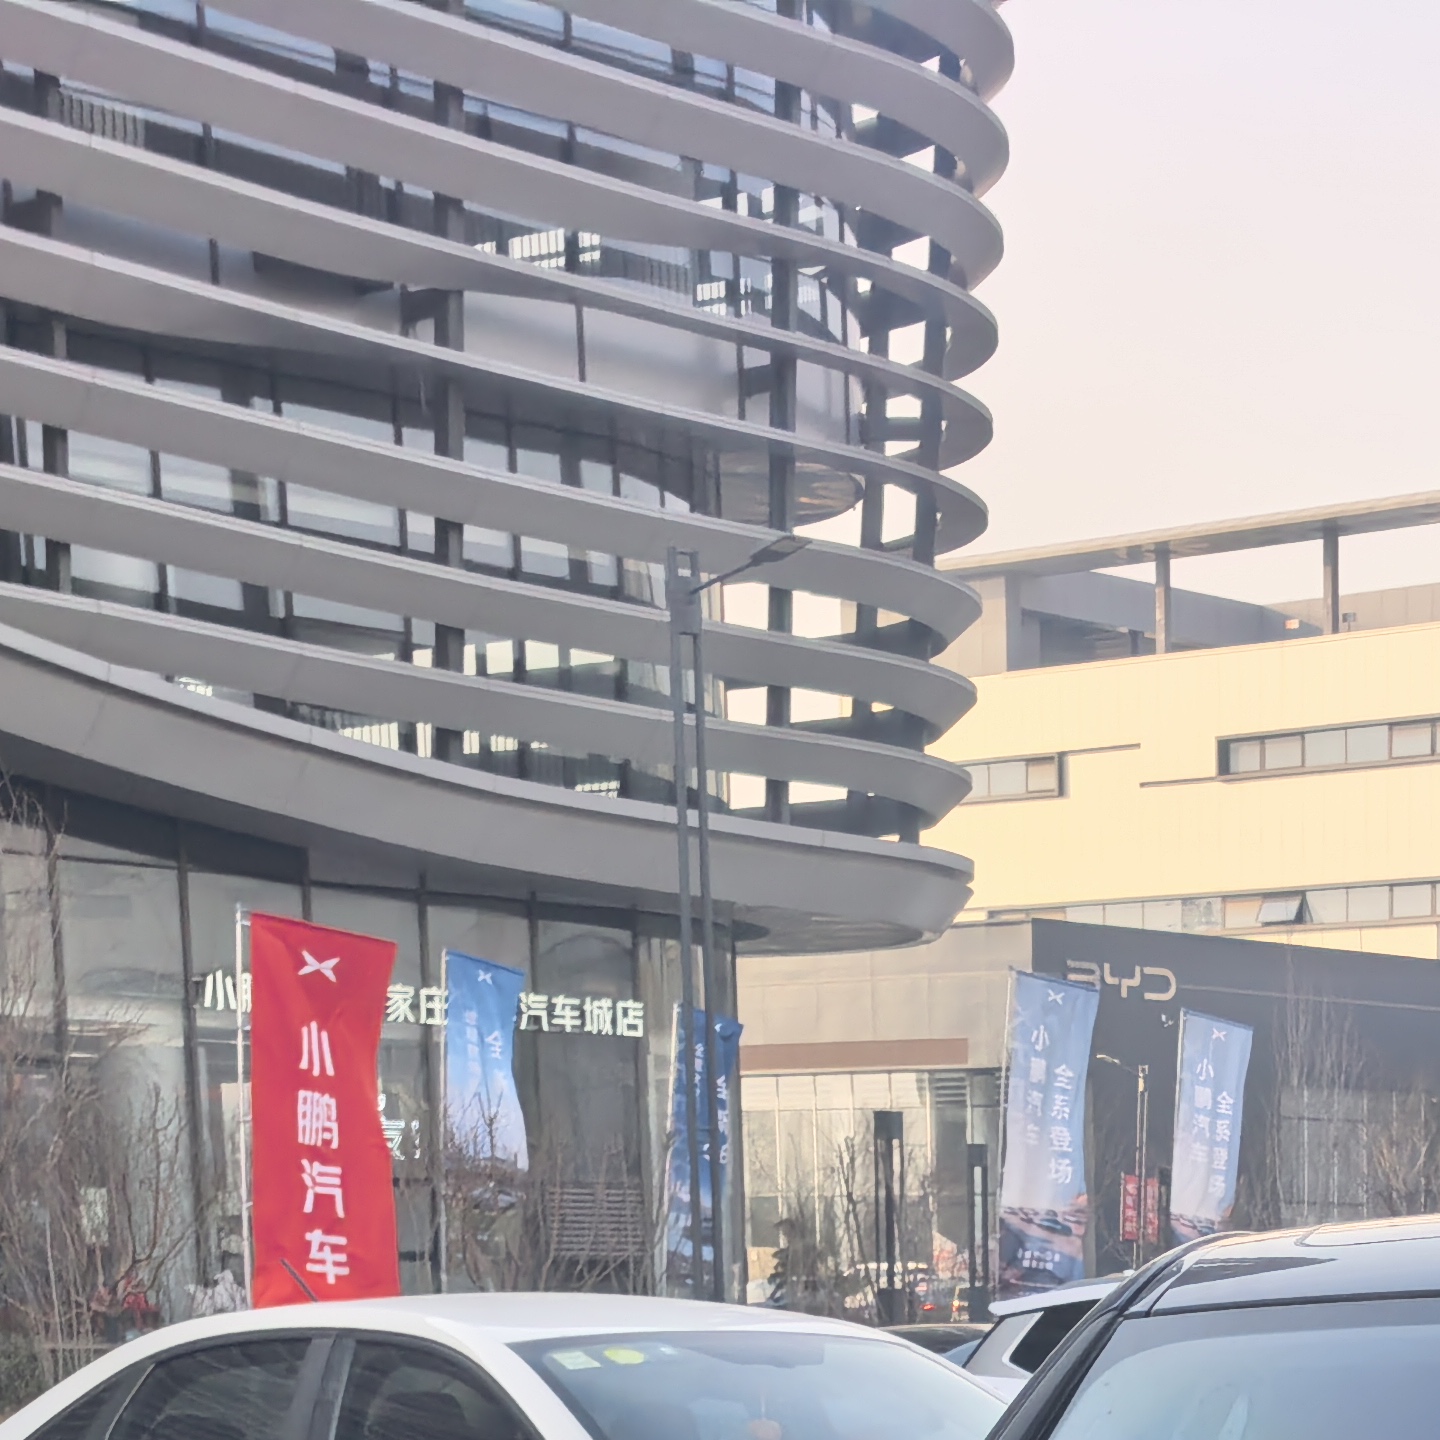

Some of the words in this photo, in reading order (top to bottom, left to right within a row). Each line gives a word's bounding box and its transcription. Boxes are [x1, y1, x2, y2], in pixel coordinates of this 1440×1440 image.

[1067, 959, 1177, 1001] BYD
[296, 1020, 350, 1285] 小鹏汽车
[1047, 1063, 1075, 1185] 全系登场
